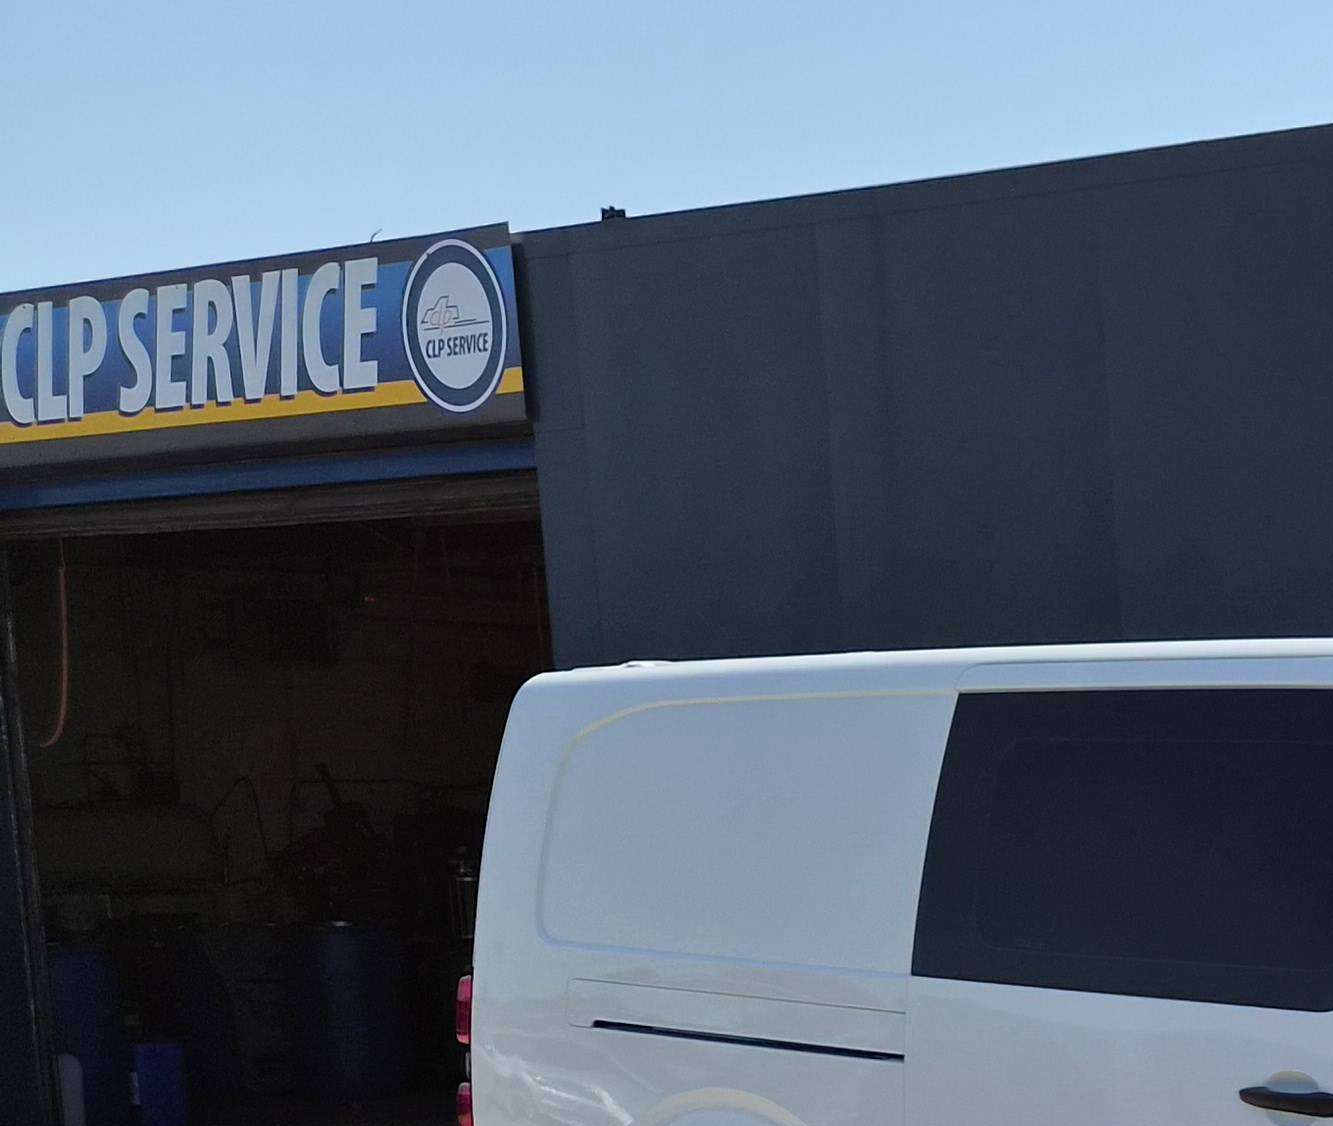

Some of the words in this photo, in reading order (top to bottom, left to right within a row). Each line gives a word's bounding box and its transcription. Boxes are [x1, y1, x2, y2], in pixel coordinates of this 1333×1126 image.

[1, 296, 107, 424] CLP
[118, 257, 379, 413] SERVICE
[426, 338, 445, 358] CLP
[447, 333, 488, 356] SERVICE
